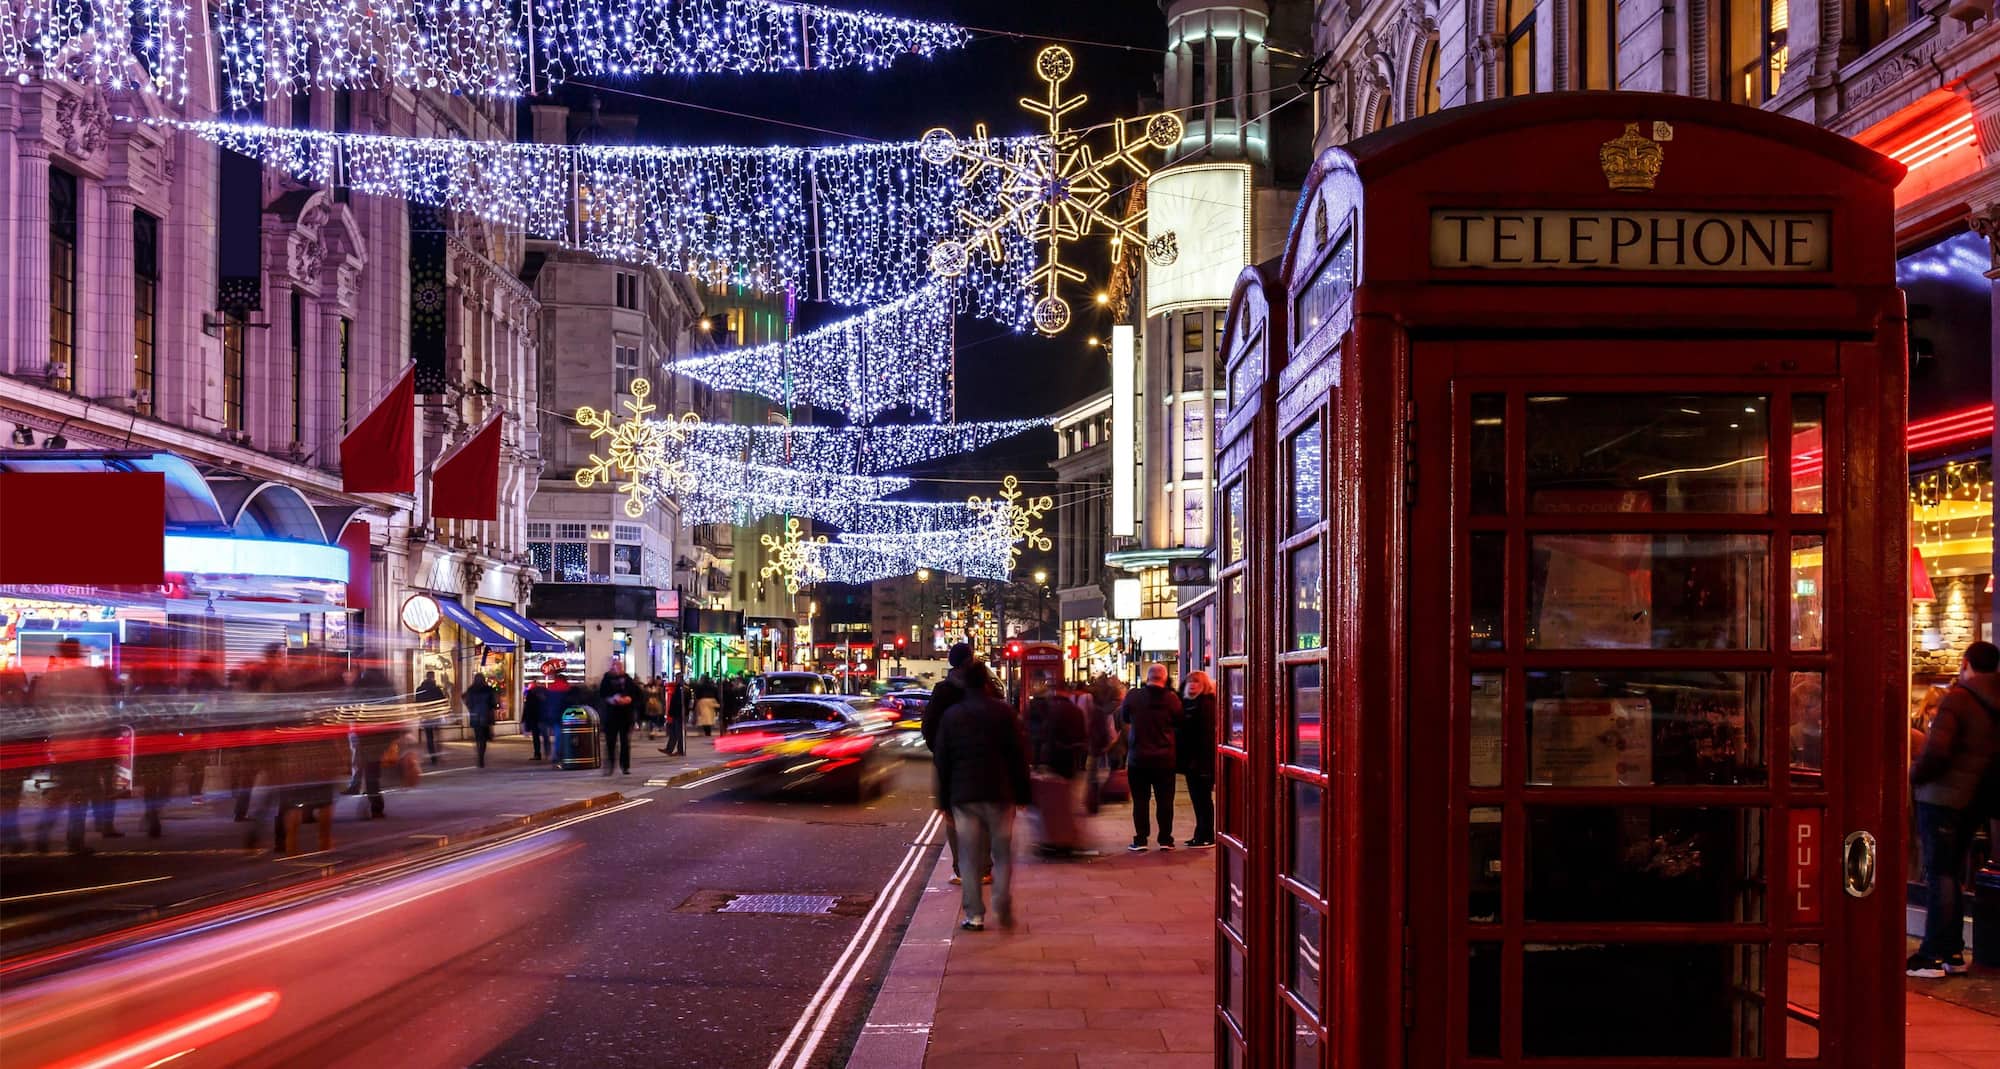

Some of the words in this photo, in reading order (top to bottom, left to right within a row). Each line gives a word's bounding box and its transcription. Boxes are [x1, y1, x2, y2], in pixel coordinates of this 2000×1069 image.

[1442, 214, 1813, 266] TELEPHONE
[20, 583, 33, 594] &
[33, 583, 98, 596] Souvenir
[542, 660, 567, 674] SALE
[1797, 823, 1812, 911] PULL
